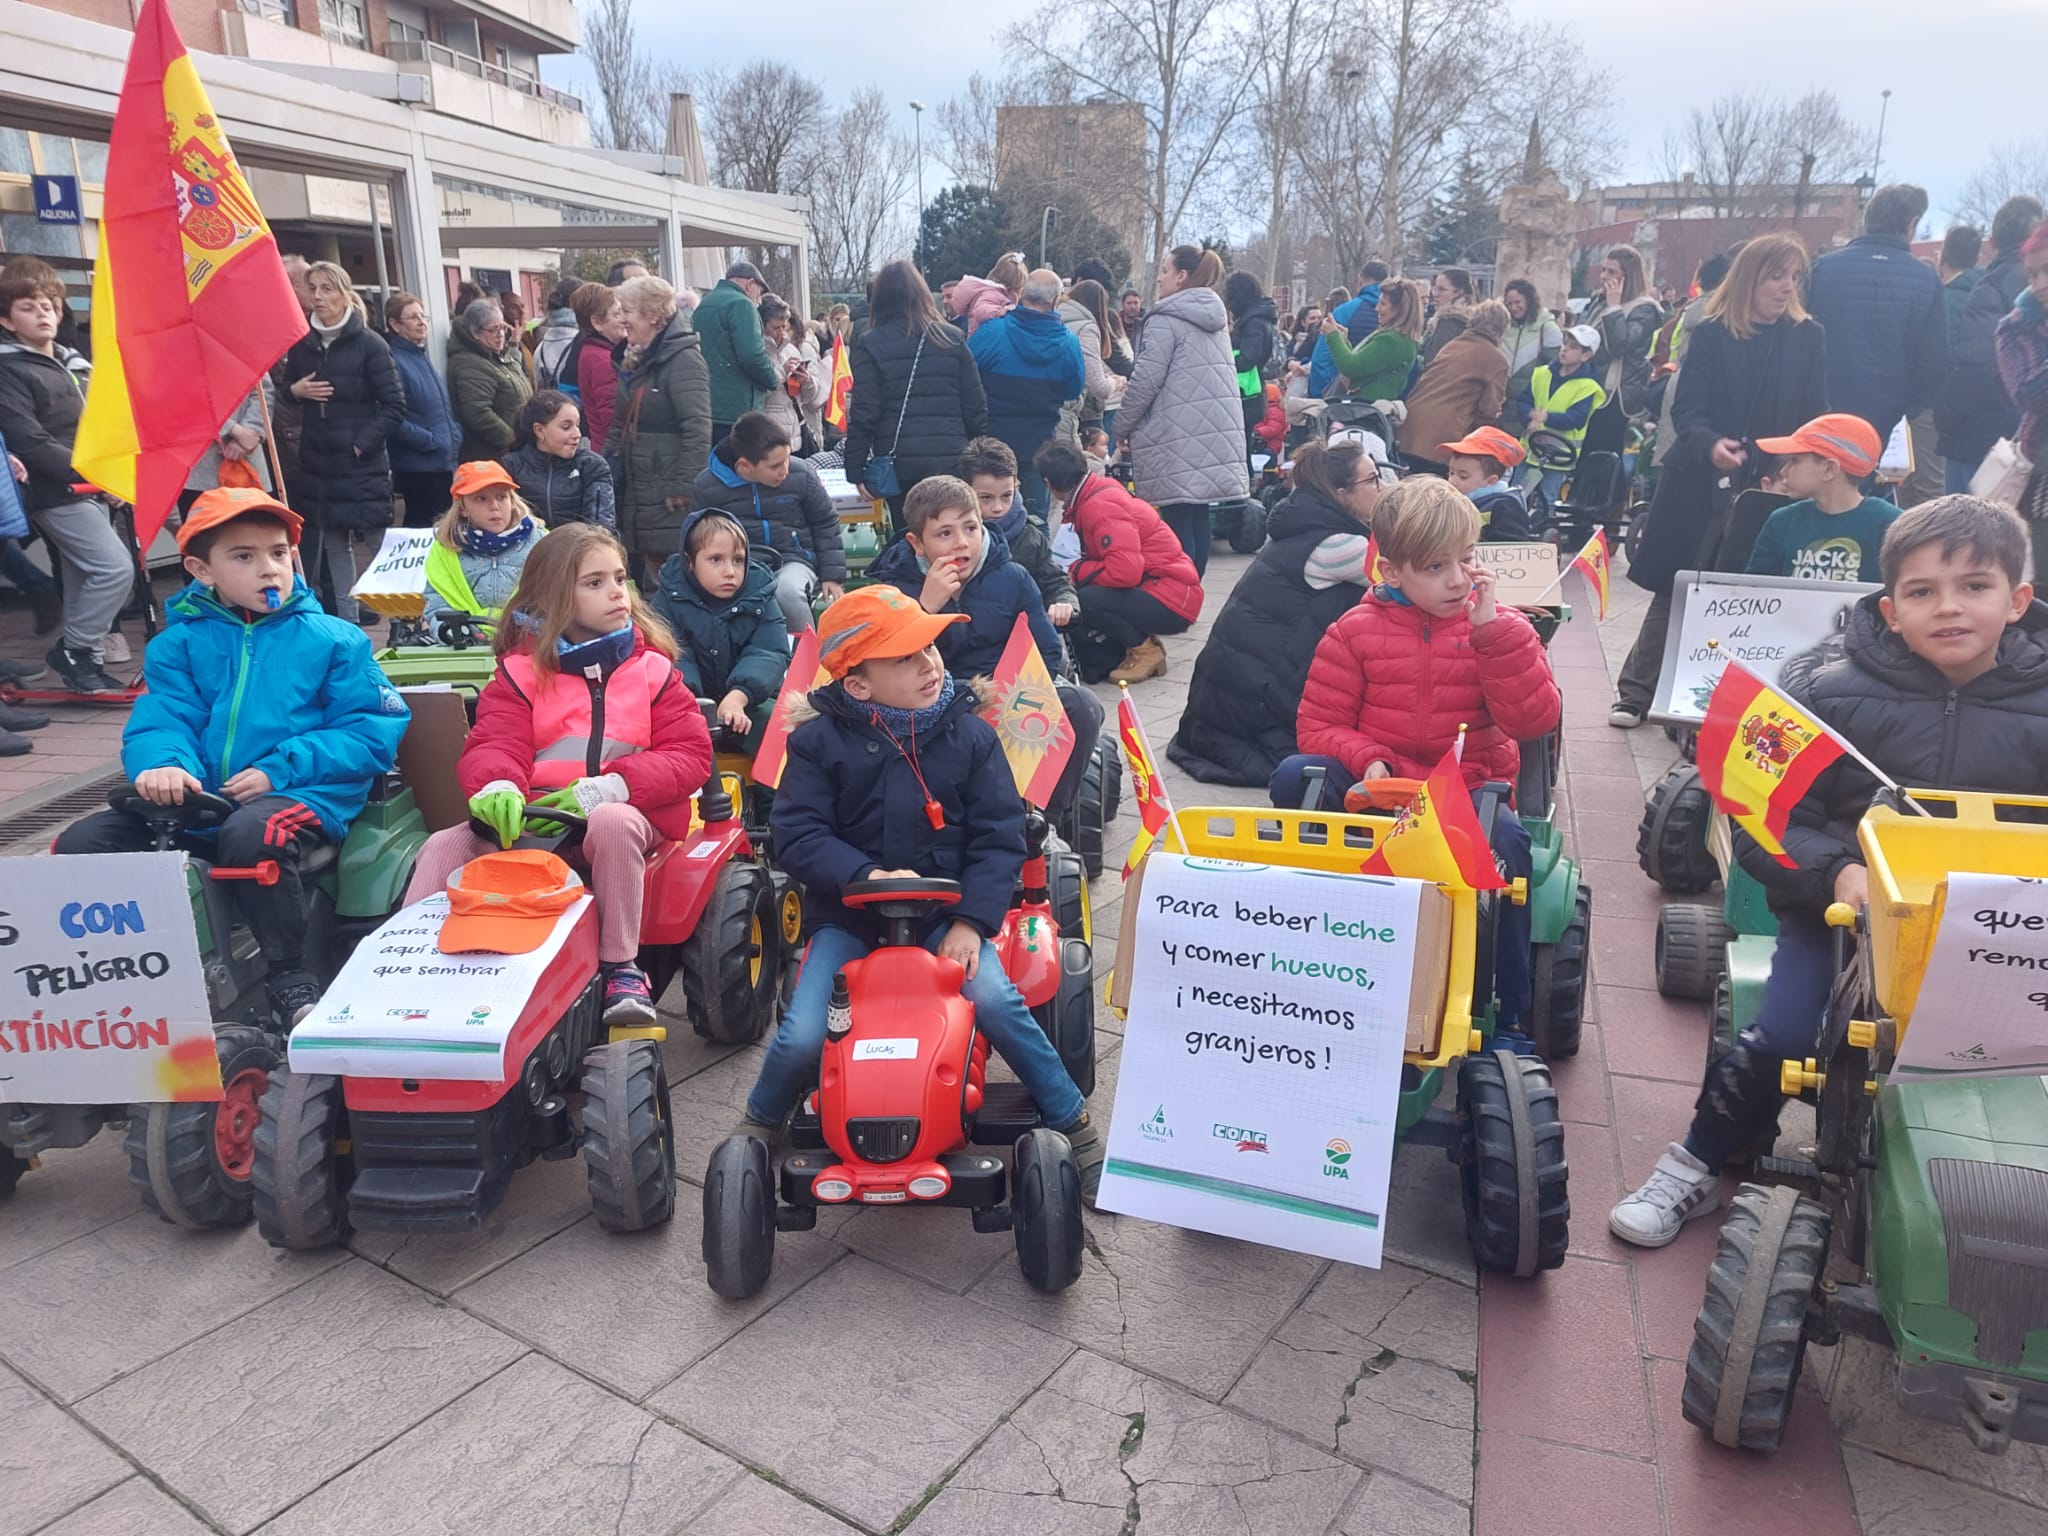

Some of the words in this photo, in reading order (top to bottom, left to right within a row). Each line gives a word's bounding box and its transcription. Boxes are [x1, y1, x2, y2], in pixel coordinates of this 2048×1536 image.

[40, 209, 77, 220] AQUONA
[407, 537, 434, 550] NU
[1474, 548, 1554, 563] NUESTRO
[373, 556, 425, 574] FUTUR
[1495, 568, 1527, 580] RO
[1704, 598, 1782, 617] ASESINO
[1729, 624, 1753, 638] del
[1735, 646, 1786, 661] DEERE
[59, 900, 145, 939] CON
[1156, 895, 1219, 919] Para
[1235, 901, 1317, 933] beber
[1323, 912, 1396, 943] leche
[379, 927, 428, 939] para
[379, 944, 429, 957] aquí
[373, 965, 412, 977] que
[418, 963, 506, 977] sembrar
[1185, 944, 1266, 969] comer
[1271, 952, 1376, 991] huevos,
[466, 1018, 485, 1026] UPA
[1138, 1122, 1174, 1138] ASAJA
[1213, 1124, 1268, 1145] COAG
[1323, 1164, 1350, 1180] UPA
